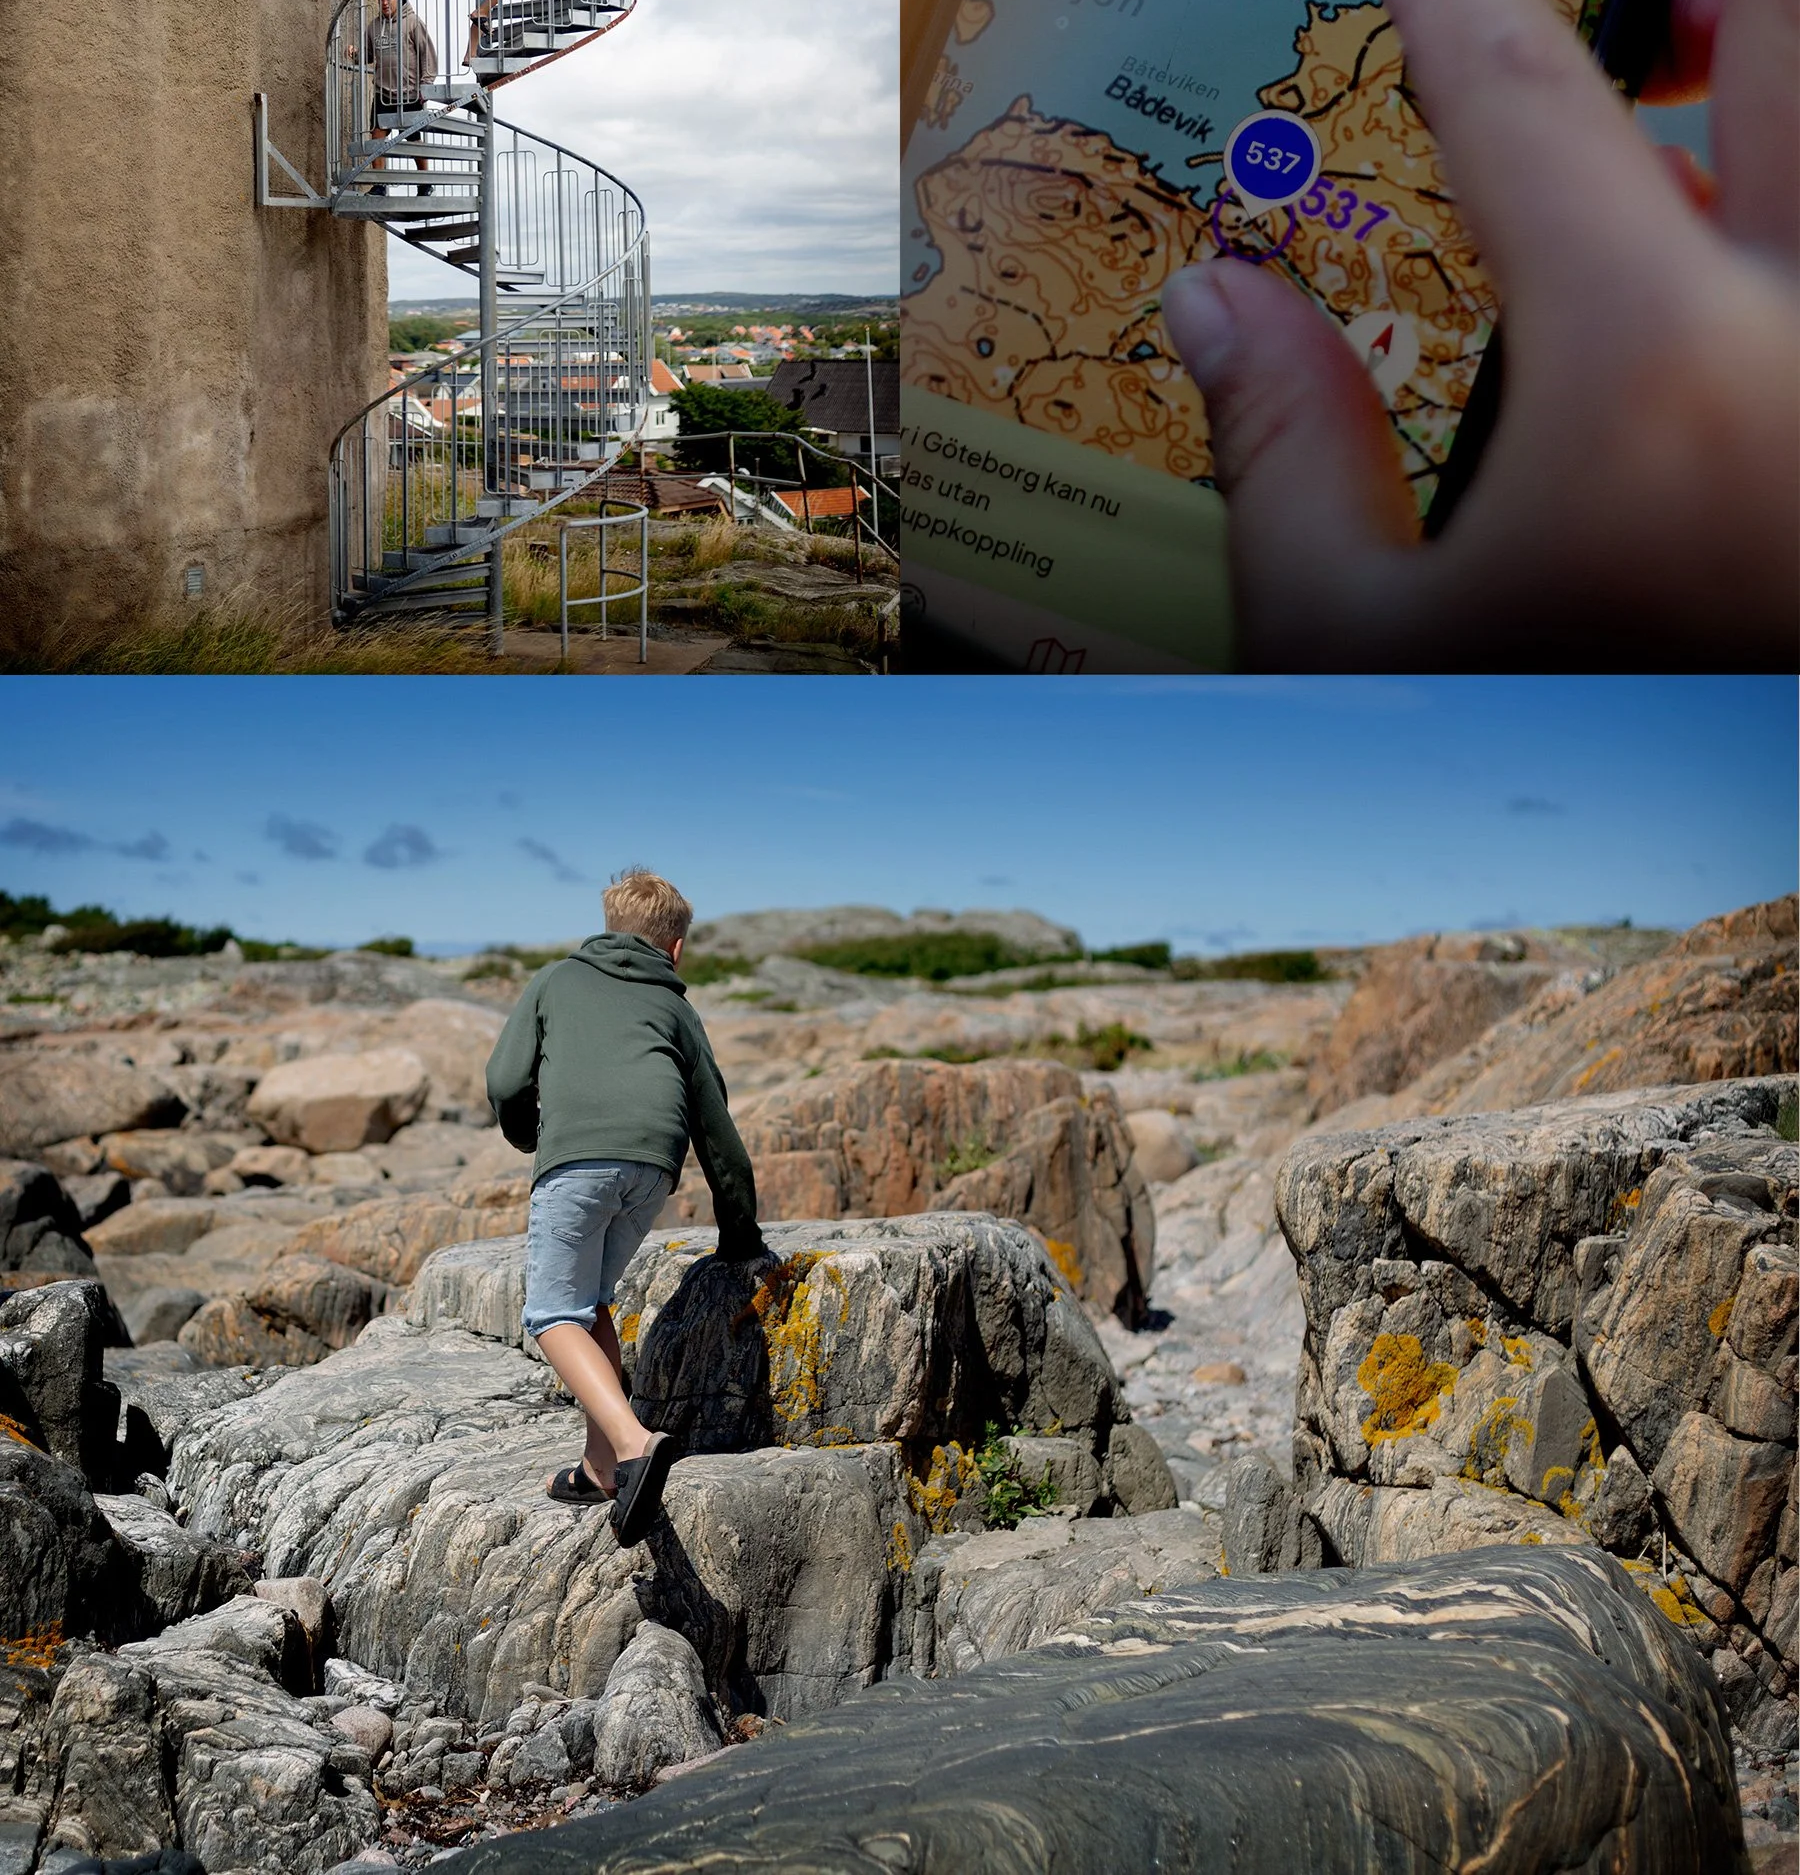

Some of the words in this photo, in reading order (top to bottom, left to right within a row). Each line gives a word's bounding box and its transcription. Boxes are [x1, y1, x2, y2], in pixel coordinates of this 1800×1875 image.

[1105, 74, 1214, 144] Bådevik
[1121, 55, 1220, 100] Båteviken
[1245, 141, 1301, 174] 537
[1300, 177, 1389, 240] 537
[911, 426, 920, 446] i
[923, 431, 1040, 492] Göteborg
[1043, 472, 1086, 505] kan
[1090, 493, 1121, 517] nu
[938, 480, 991, 511] utan
[900, 505, 1054, 578] uppkoppling
